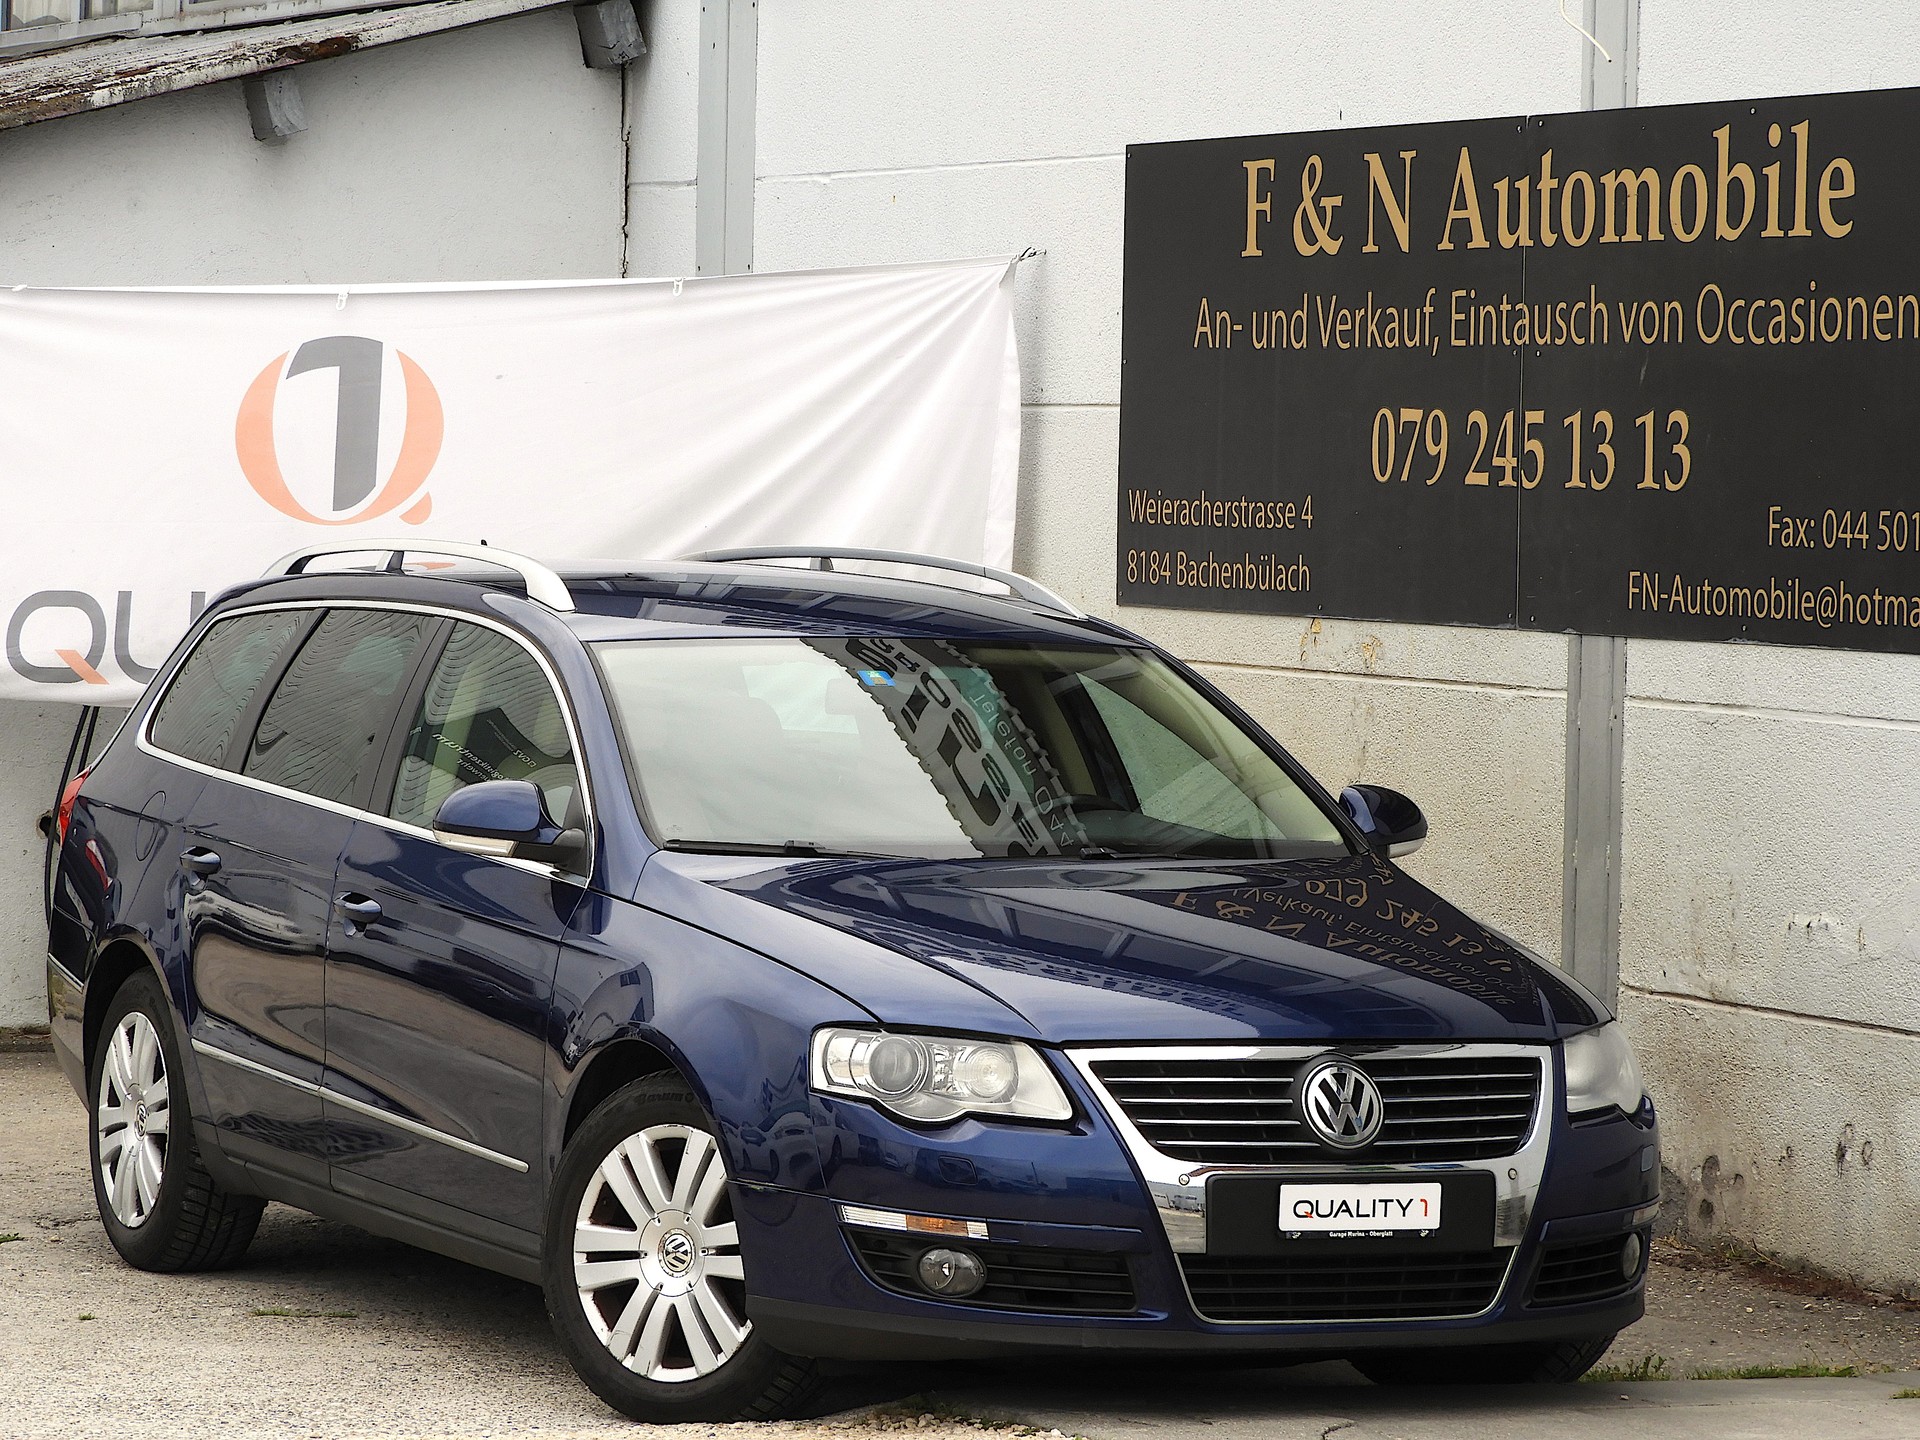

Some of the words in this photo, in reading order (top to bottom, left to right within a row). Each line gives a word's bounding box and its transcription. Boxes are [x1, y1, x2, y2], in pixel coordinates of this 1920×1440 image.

[1240, 158, 1276, 258] F
[1292, 153, 1345, 257] &
[1361, 149, 1417, 254] N
[1437, 118, 1857, 251] Automobile
[1194, 296, 1243, 349] An-
[1251, 293, 1309, 350] und
[1316, 286, 1440, 357] Verkauf,
[1449, 284, 1609, 348] Eintausch
[1618, 300, 1684, 345] von
[1696, 280, 1920, 345] Occasionen
[1371, 406, 1449, 486] 079
[1464, 408, 1545, 489] 245
[1563, 410, 1616, 490] 13
[1635, 409, 1692, 492] 13
[1129, 490, 1296, 529] Weieracherstrasse
[1301, 494, 1313, 529] 4
[1768, 506, 1815, 549] Fax:
[1822, 509, 1870, 550] 044
[1876, 510, 1920, 552] 501
[1127, 550, 1172, 587] 8184
[1176, 550, 1311, 592] Bachenbülach
[1292, 1197, 1414, 1220] QUALITY
